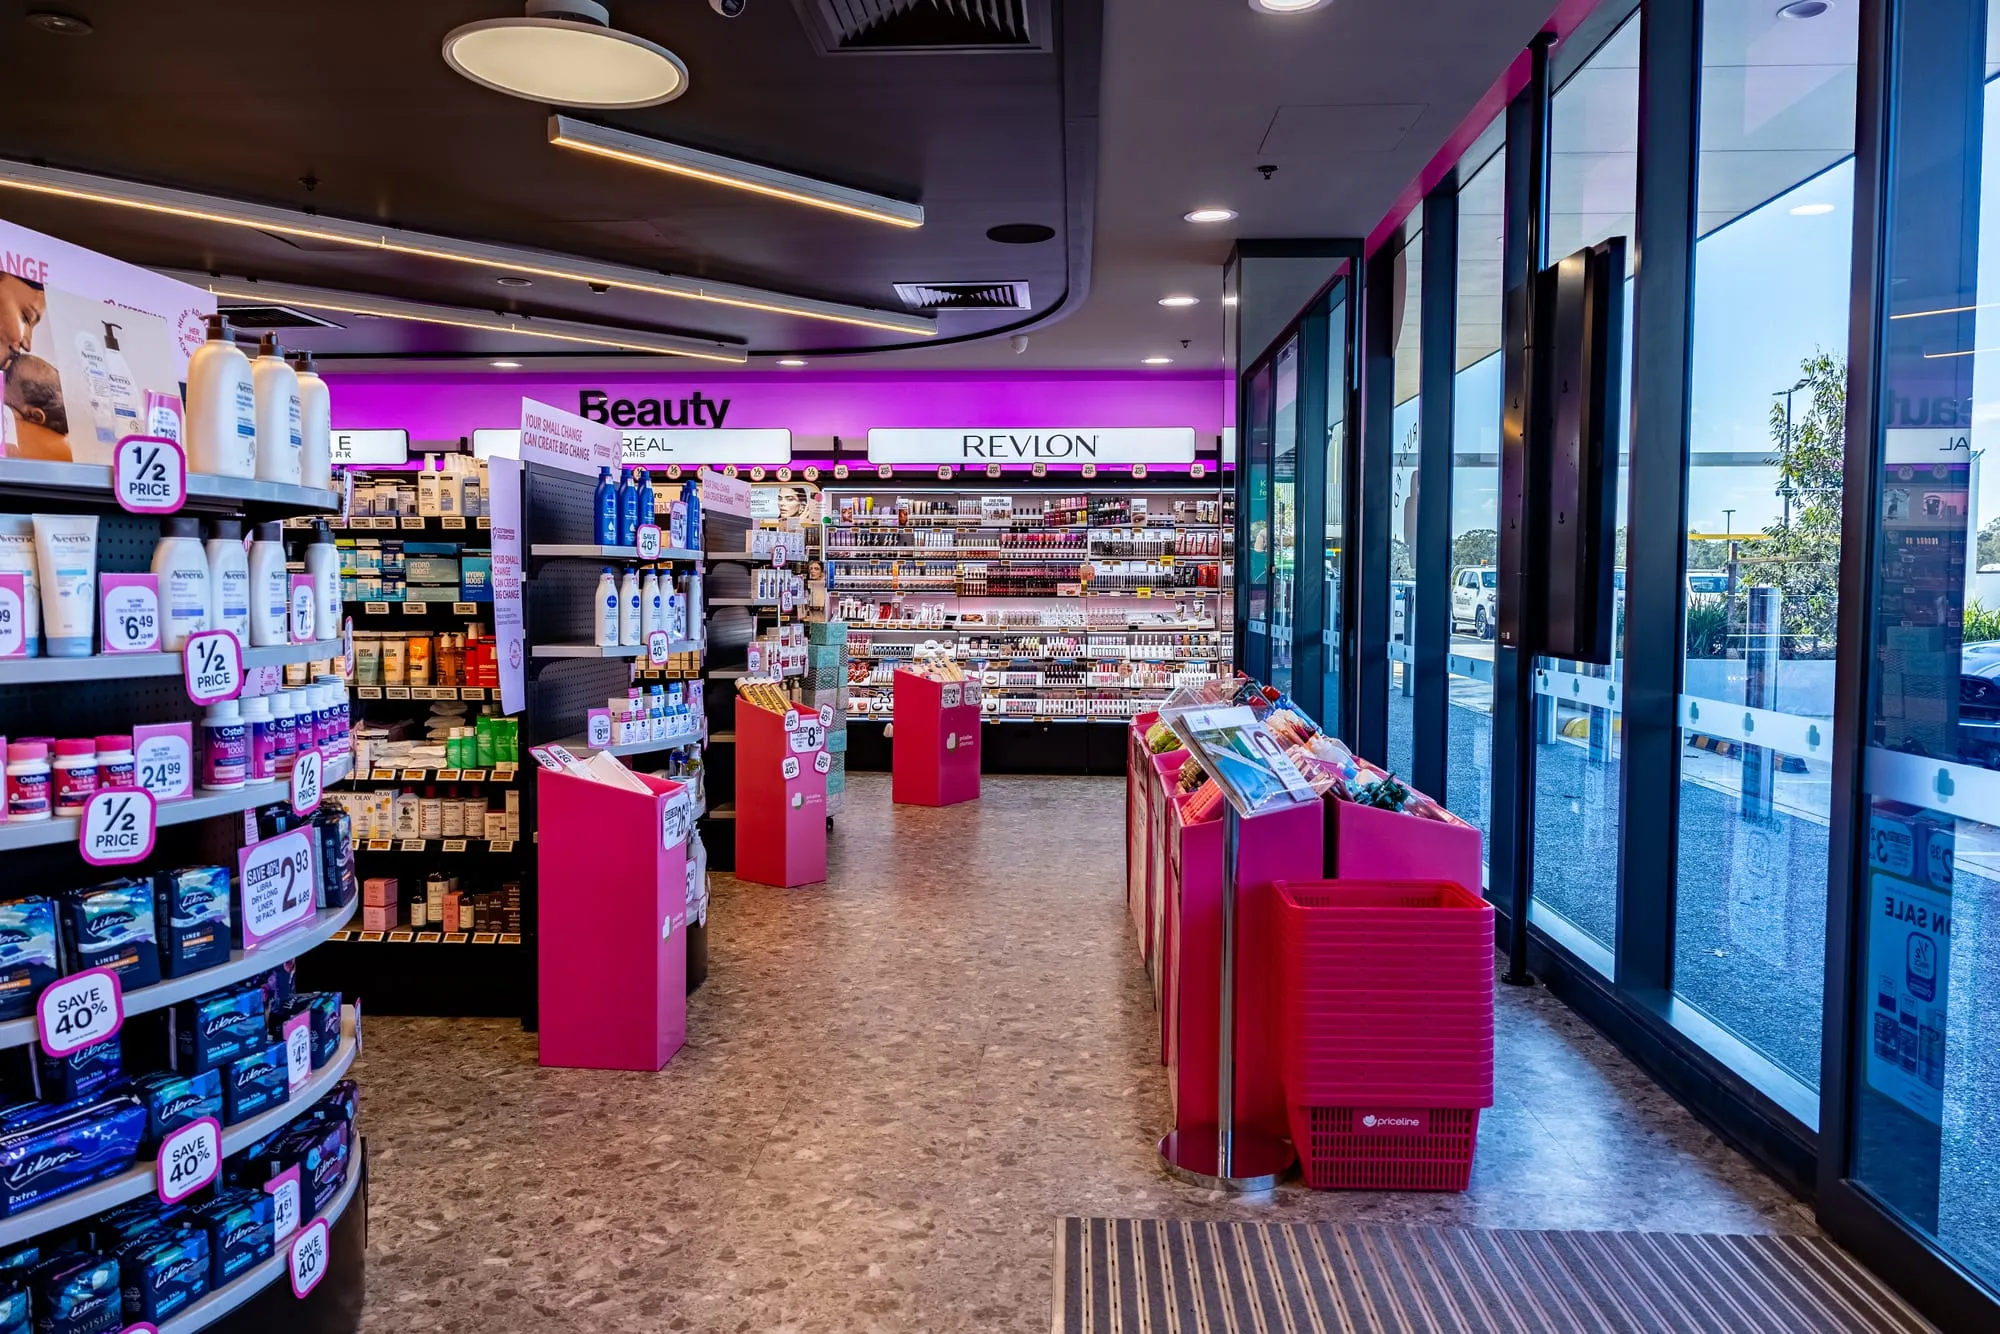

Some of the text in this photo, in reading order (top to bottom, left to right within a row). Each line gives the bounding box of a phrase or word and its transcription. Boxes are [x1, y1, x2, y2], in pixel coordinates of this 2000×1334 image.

[184, 333, 205, 346] HEALTH
[188, 326, 200, 337] HER
[579, 390, 732, 429] Beauty
[525, 412, 583, 443] YOUR SMALL CHANGE
[523, 431, 538, 448] CAN
[538, 435, 559, 454] CREATE
[559, 440, 569, 457] BIG
[569, 443, 590, 462] CHANGE
[963, 434, 1097, 458] REVLON
[129, 482, 171, 497] PRICE
[641, 540, 657, 551] 40%
[643, 533, 656, 541] SAVE
[171, 569, 204, 580] Aveeno
[197, 672, 231, 689] PRICE
[298, 785, 317, 801] PRICE
[96, 833, 139, 848] PRICE
[247, 865, 266, 886] SAVE
[251, 888, 279, 905] DRY LONG
[256, 881, 272, 893] LIBRA
[182, 893, 214, 909] Libra
[257, 900, 273, 912] LINER
[90, 914, 133, 932] Libra
[262, 908, 277, 920] PACK
[95, 954, 120, 966] LINER
[58, 988, 100, 1013] SAVE
[55, 1001, 108, 1035] 40%
[206, 1013, 249, 1035] Libra
[237, 1064, 276, 1087] Libra
[161, 1096, 205, 1120] Libra
[1377, 1117, 1420, 1127] priceline
[172, 1136, 205, 1163] SAVE
[11, 1151, 82, 1181] Libra
[169, 1147, 210, 1183] 40%
[9, 1190, 38, 1204] Extra
[225, 1223, 260, 1248] Libra
[299, 1235, 320, 1261] SAVE
[299, 1245, 322, 1279] 40%
[155, 1260, 194, 1289] Libra
[71, 1297, 108, 1318] Libra
